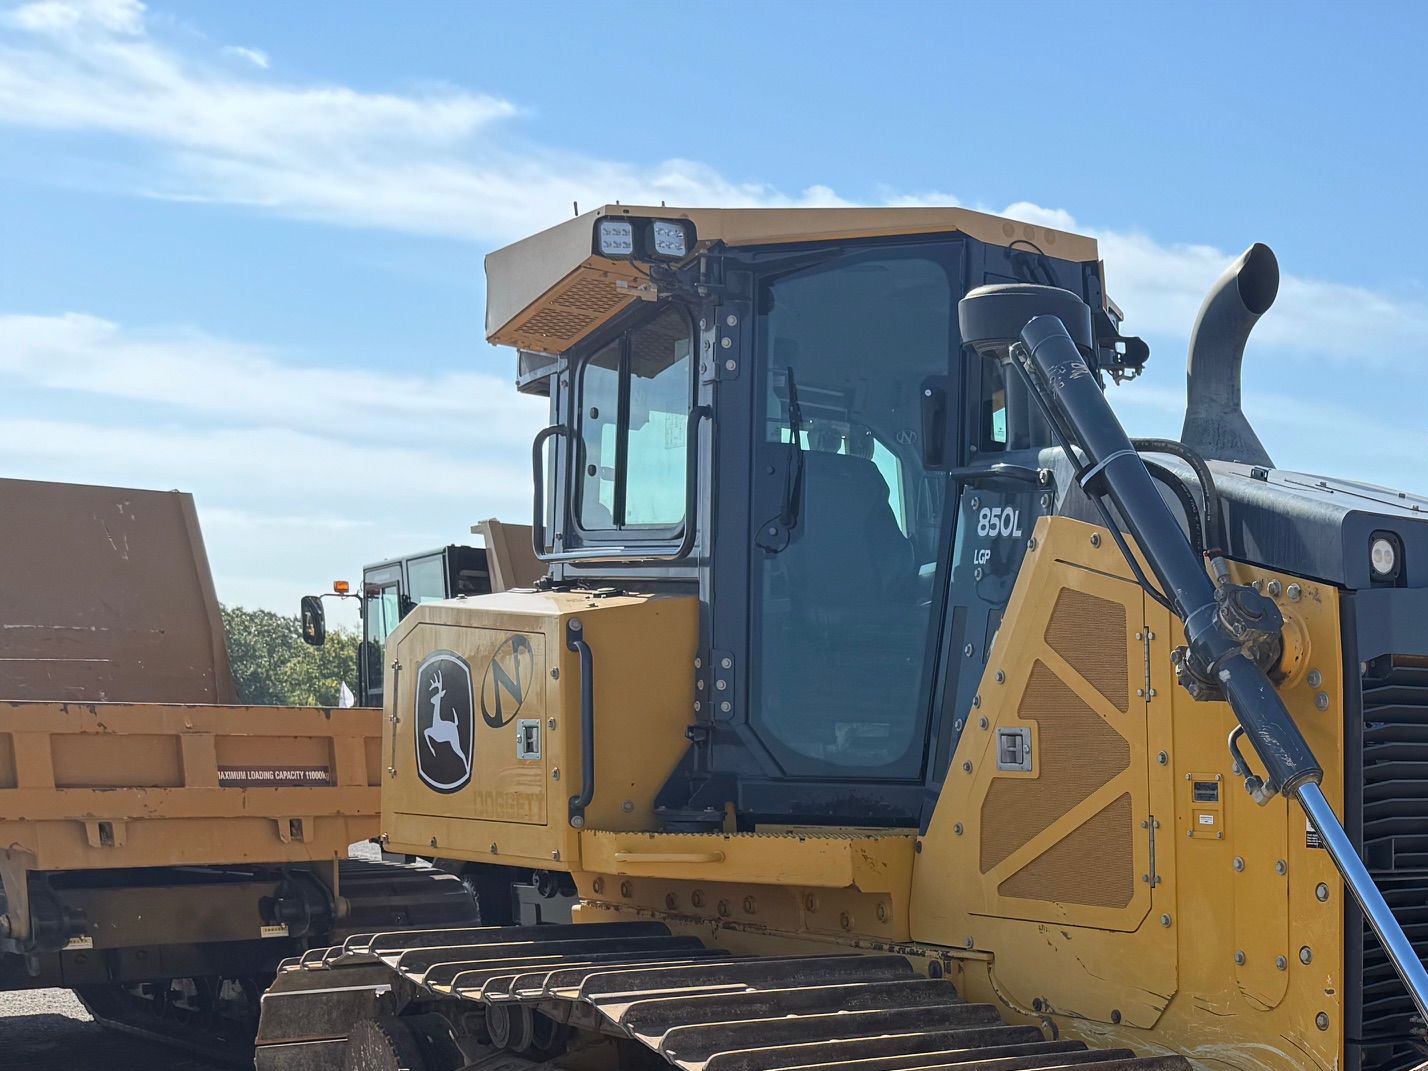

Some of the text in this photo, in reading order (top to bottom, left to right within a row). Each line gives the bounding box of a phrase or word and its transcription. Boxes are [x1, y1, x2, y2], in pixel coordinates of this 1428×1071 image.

[977, 506, 1022, 537] 850L
[973, 549, 991, 565] LGP
[247, 770, 274, 780] LOADING
[274, 770, 304, 780] CAPACITY
